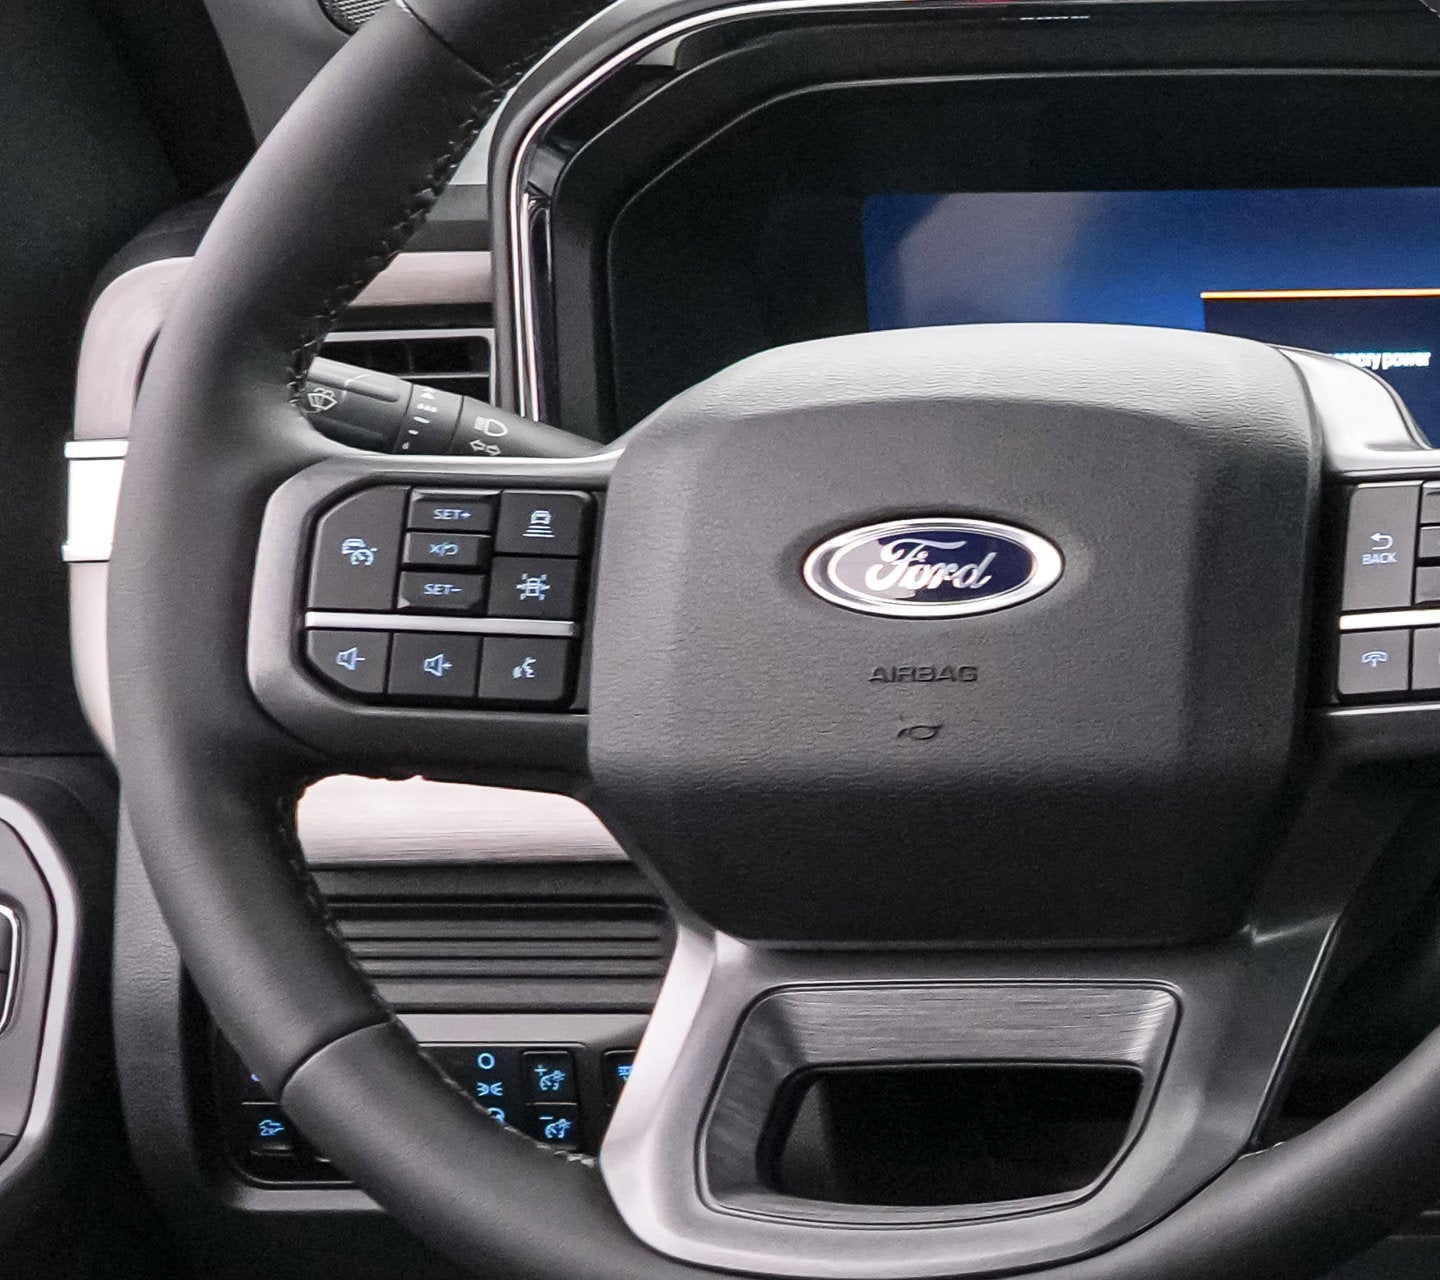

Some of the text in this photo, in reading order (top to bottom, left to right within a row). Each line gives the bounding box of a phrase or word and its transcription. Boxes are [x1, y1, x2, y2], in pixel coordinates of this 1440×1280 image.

[864, 536, 992, 592] Ford
[1362, 553, 1398, 566] BACK
[867, 662, 979, 686] AIRBAG
